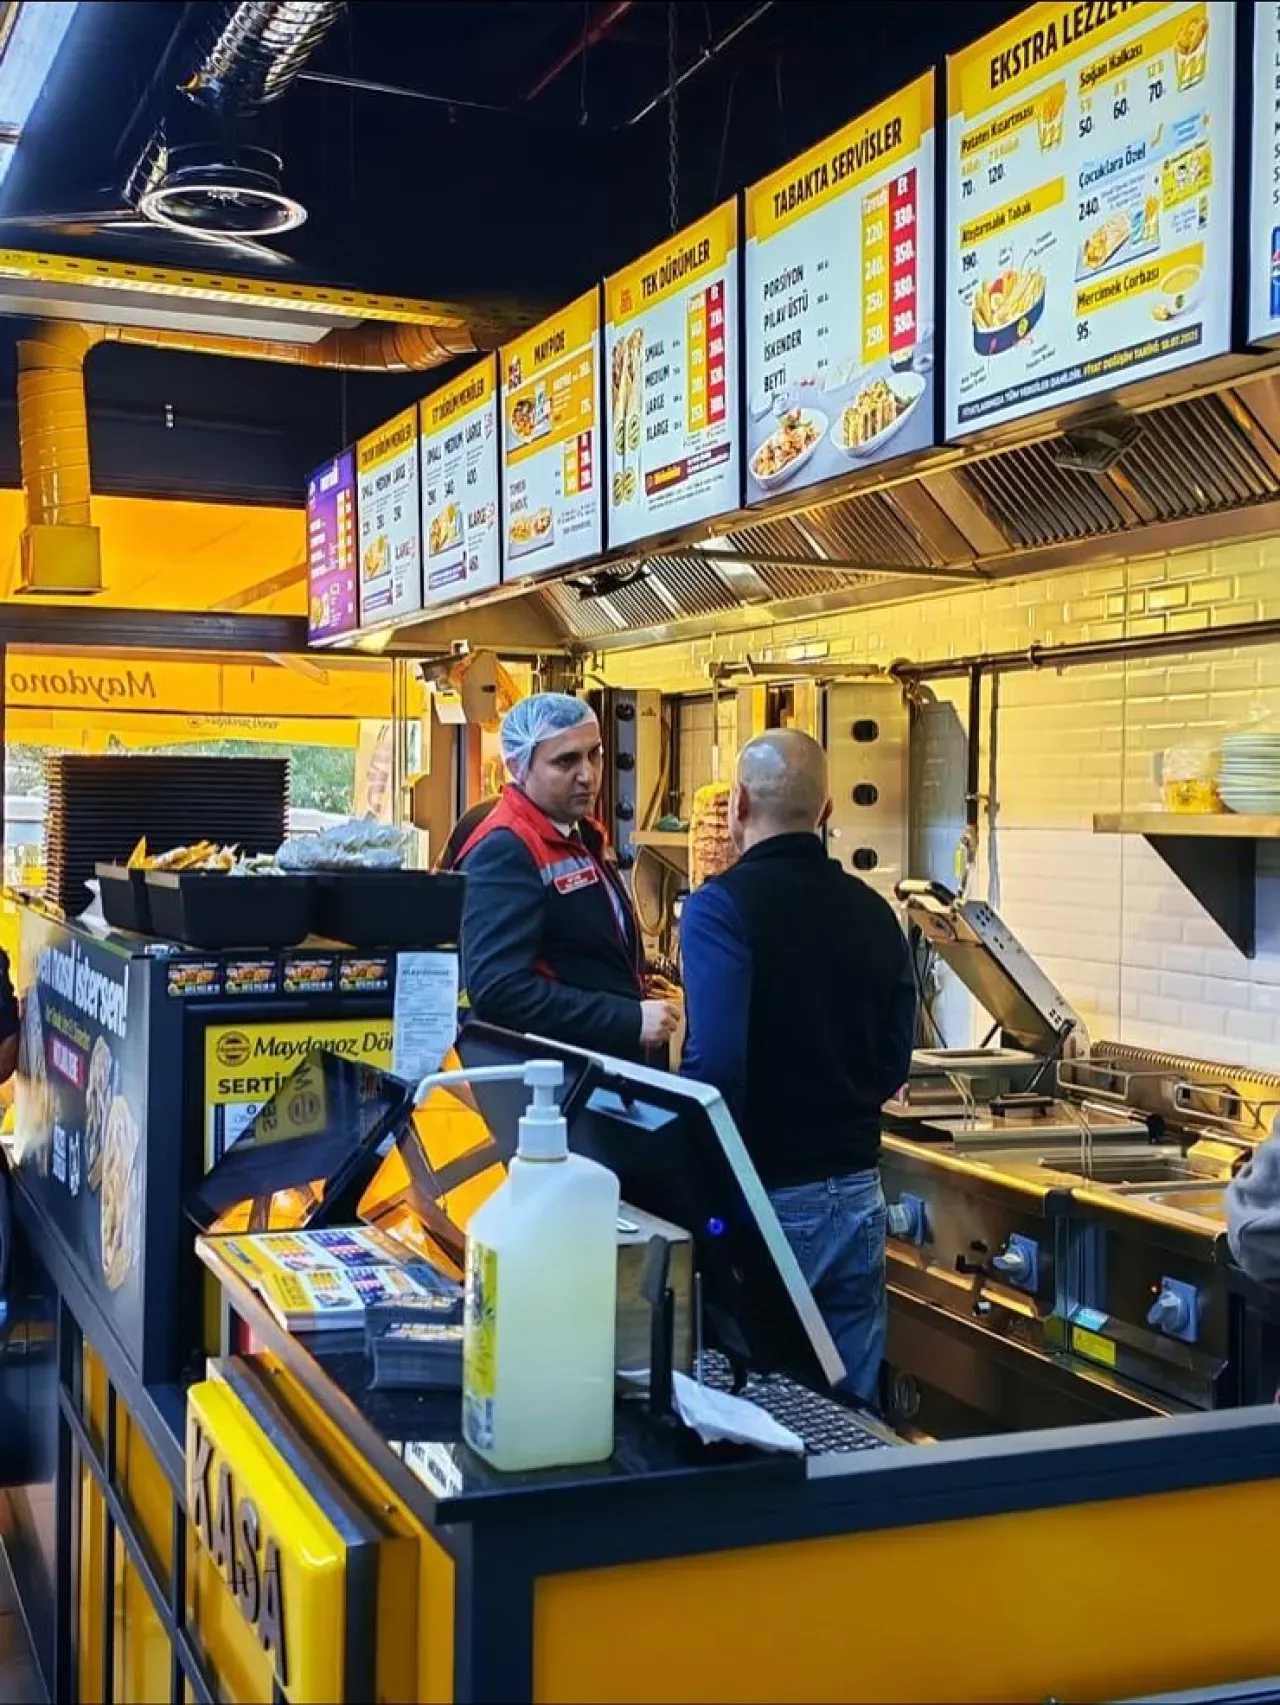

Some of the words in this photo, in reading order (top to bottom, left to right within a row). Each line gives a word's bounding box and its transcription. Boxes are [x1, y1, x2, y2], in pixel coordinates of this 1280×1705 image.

[990, 21, 1058, 91] EKSTRA
[773, 162, 829, 219] TABAKTA
[831, 117, 903, 185] SERVİSLER
[1078, 156, 1124, 190] Çocuklara
[1125, 141, 1147, 166] Özel
[1007, 201, 1032, 223] Tabak
[641, 268, 658, 300] TEK
[658, 237, 711, 289] DÜRÜMLER
[763, 263, 804, 302] PORSİYON
[1077, 278, 1122, 310] Mercimek
[1122, 267, 1161, 296] Çorbası
[763, 328, 802, 363] İSKENDER
[763, 362, 787, 394] BEYTİ
[75, 943, 129, 1041] istersen!
[253, 1035, 361, 1062] Maydonoz
[191, 1417, 289, 1688] KASA
